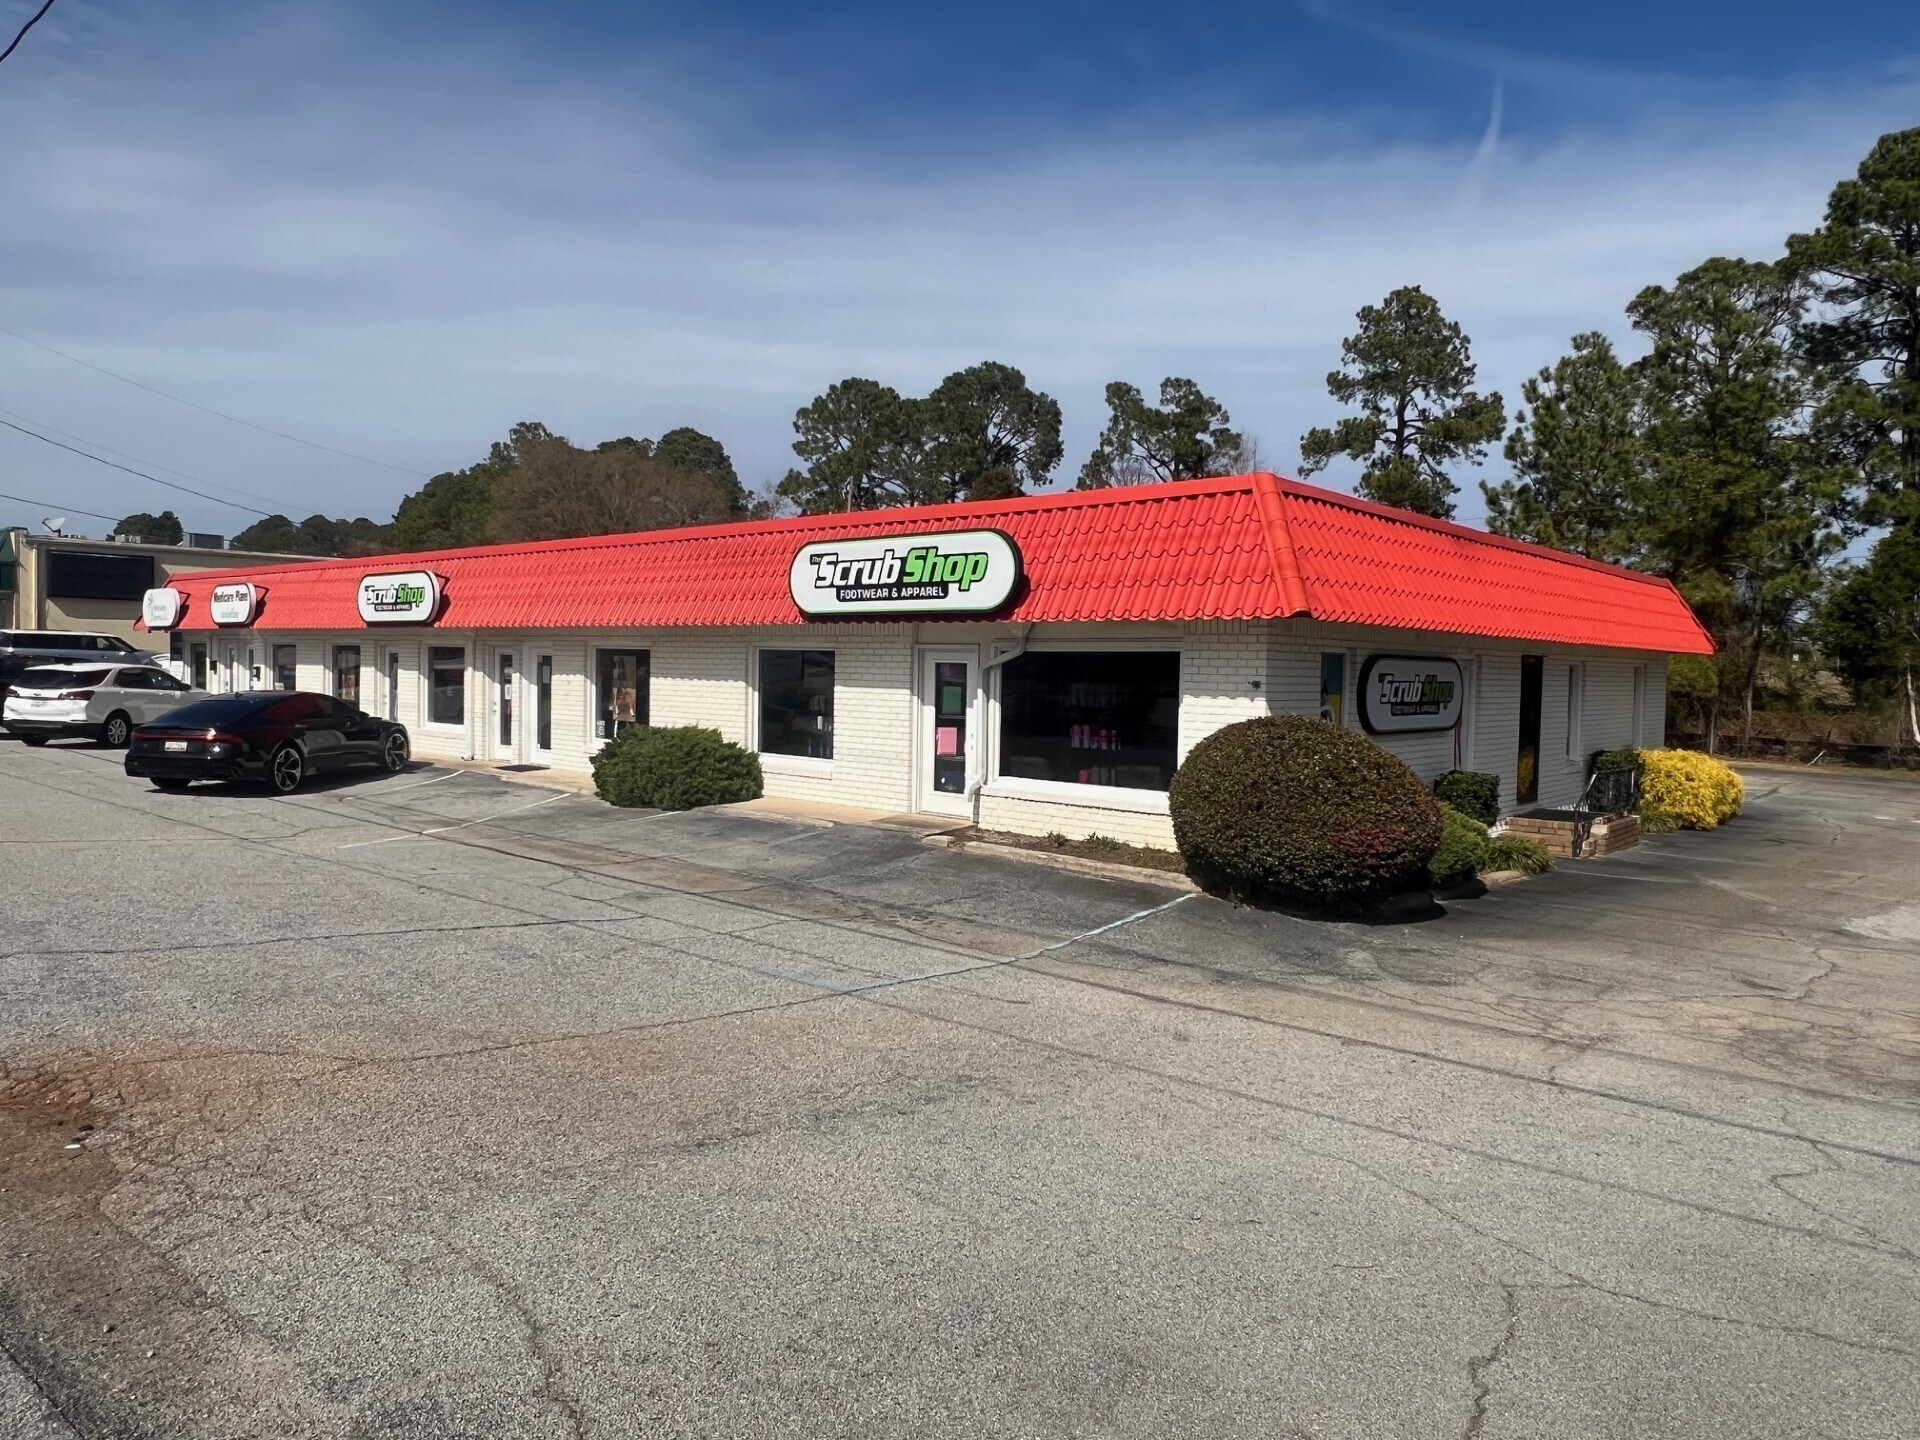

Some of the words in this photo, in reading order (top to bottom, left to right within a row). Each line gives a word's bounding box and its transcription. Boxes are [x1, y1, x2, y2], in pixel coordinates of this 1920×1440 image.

[815, 550, 902, 588] Scrub
[902, 547, 989, 591] Shop
[214, 591, 234, 603] Medicare
[236, 590, 248, 602] Plans
[367, 584, 397, 604] Scrub
[397, 584, 425, 607] Shop
[840, 588, 889, 600] FOOTWEAR
[892, 588, 899, 598] &
[901, 587, 945, 598] APPAREL
[1380, 675, 1422, 703] Scrub
[1422, 675, 1454, 709] Shop
